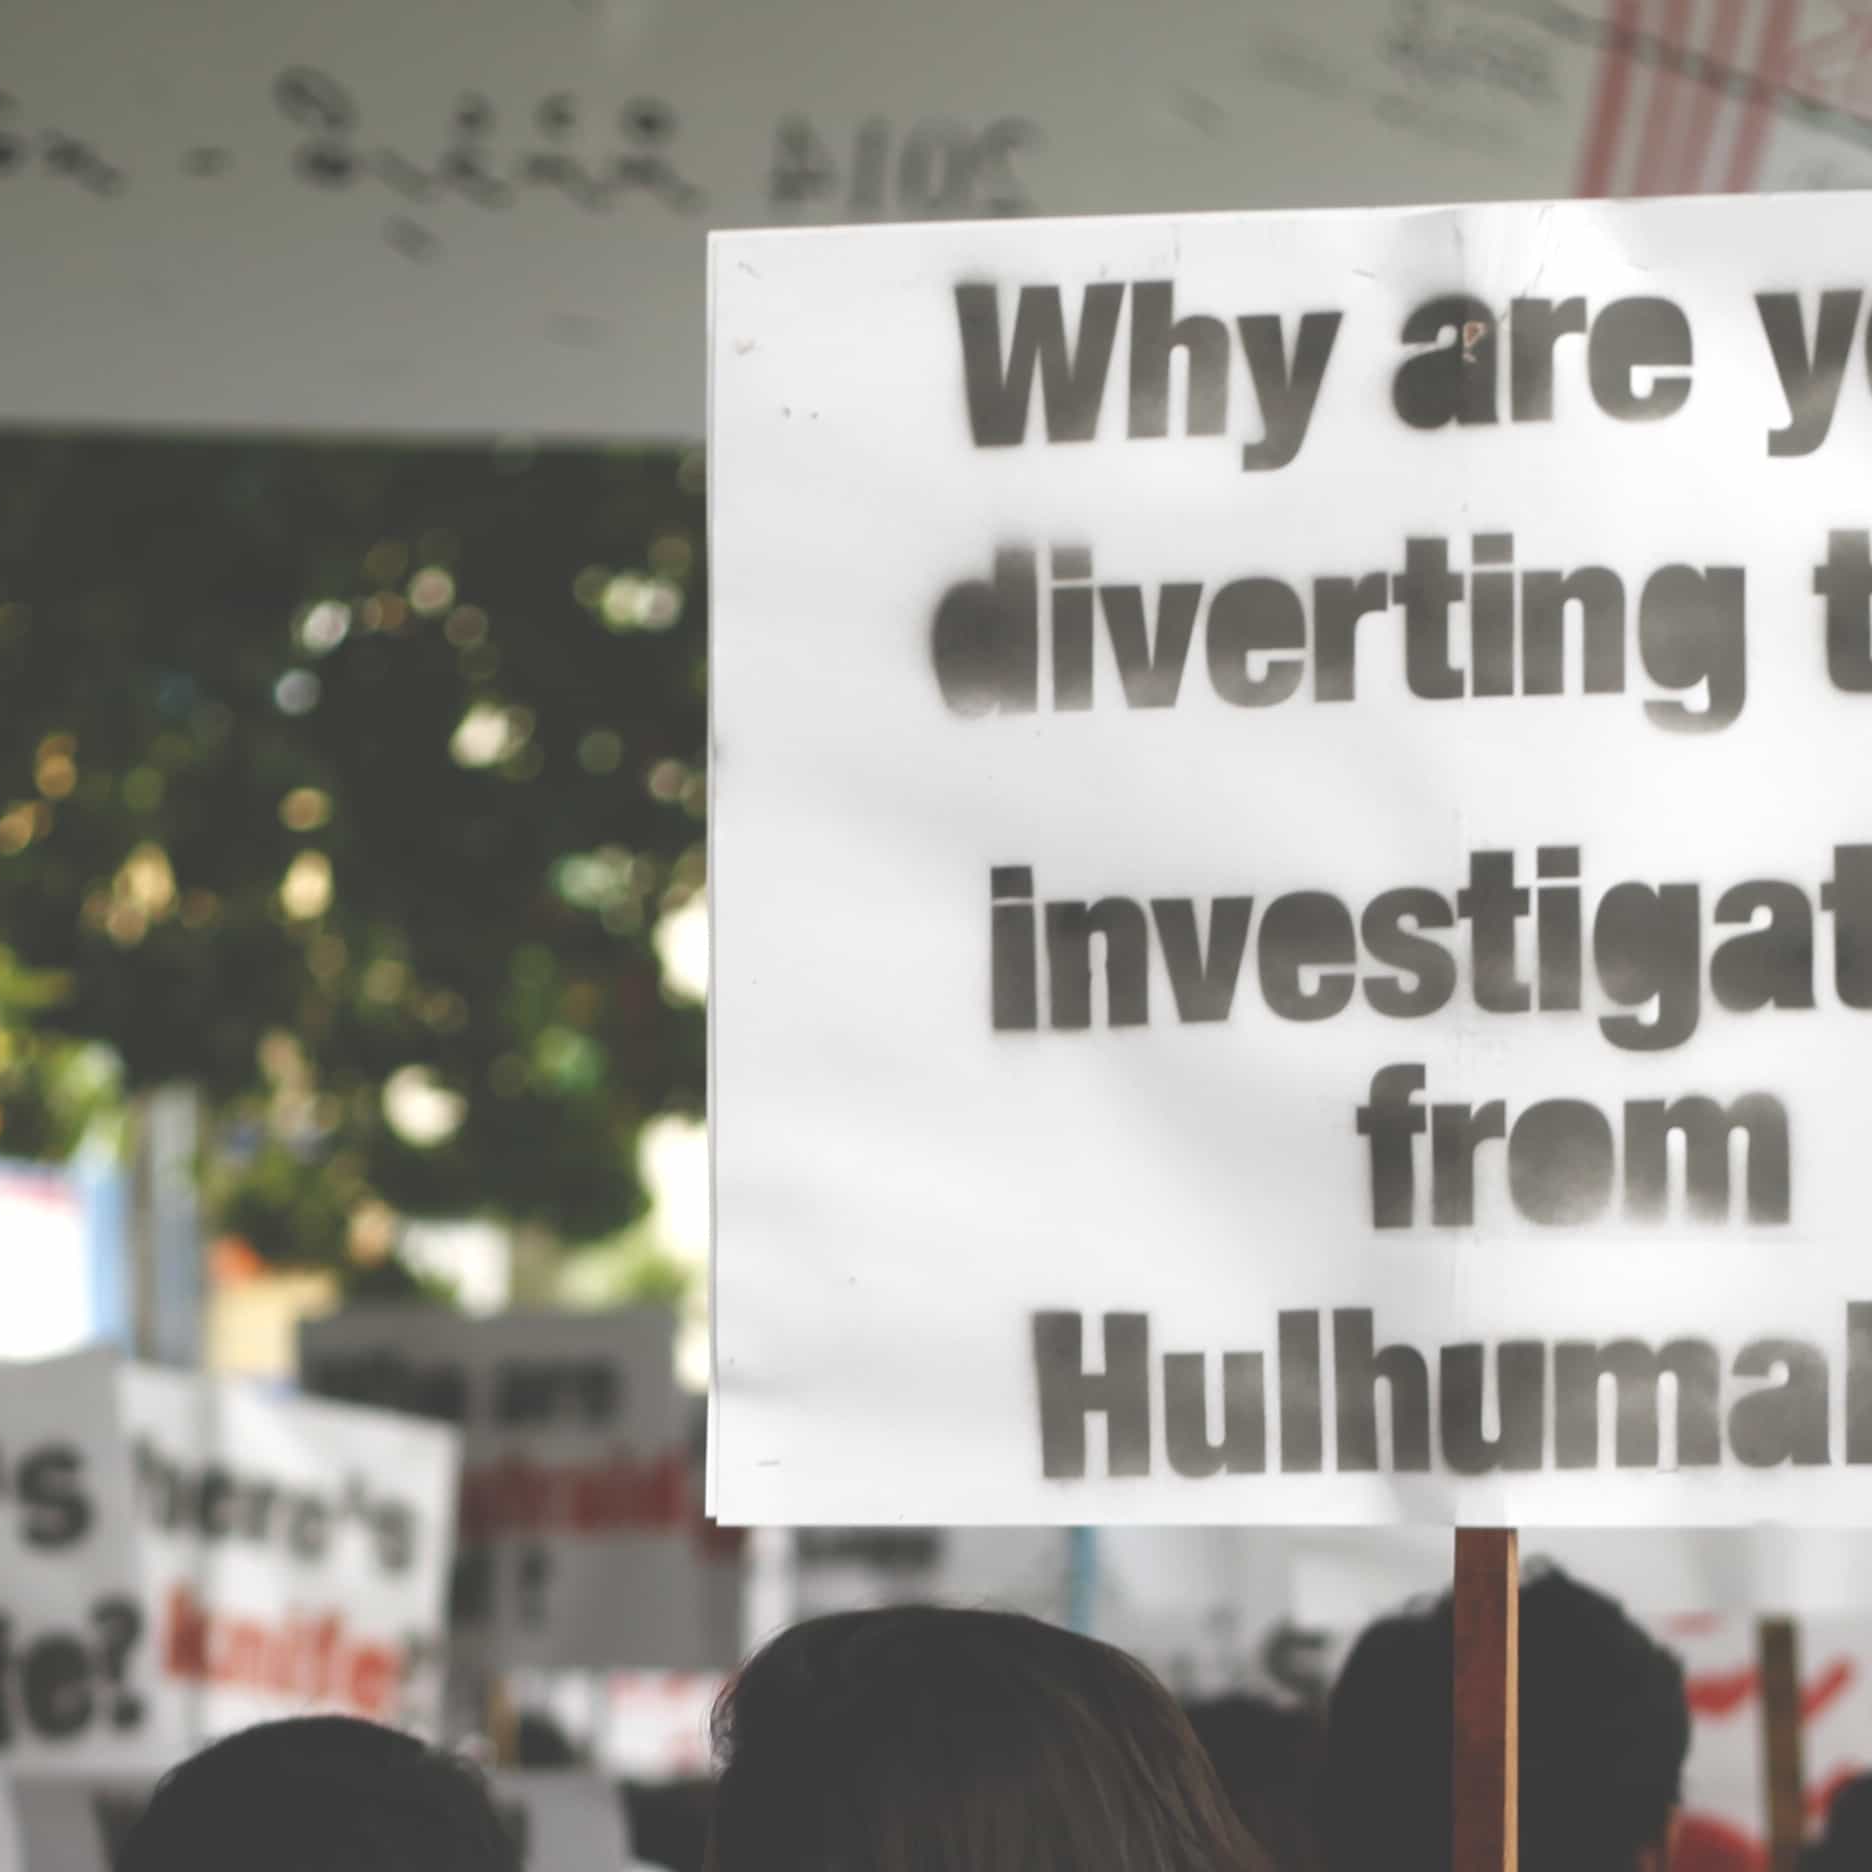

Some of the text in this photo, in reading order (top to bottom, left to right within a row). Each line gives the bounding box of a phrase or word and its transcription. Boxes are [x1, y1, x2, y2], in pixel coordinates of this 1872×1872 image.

[954, 281, 1342, 470] Why
[1391, 286, 1694, 428] are
[930, 532, 1747, 733] diverting
[1358, 1063, 1791, 1229] from
[131, 1438, 420, 1575] here's
